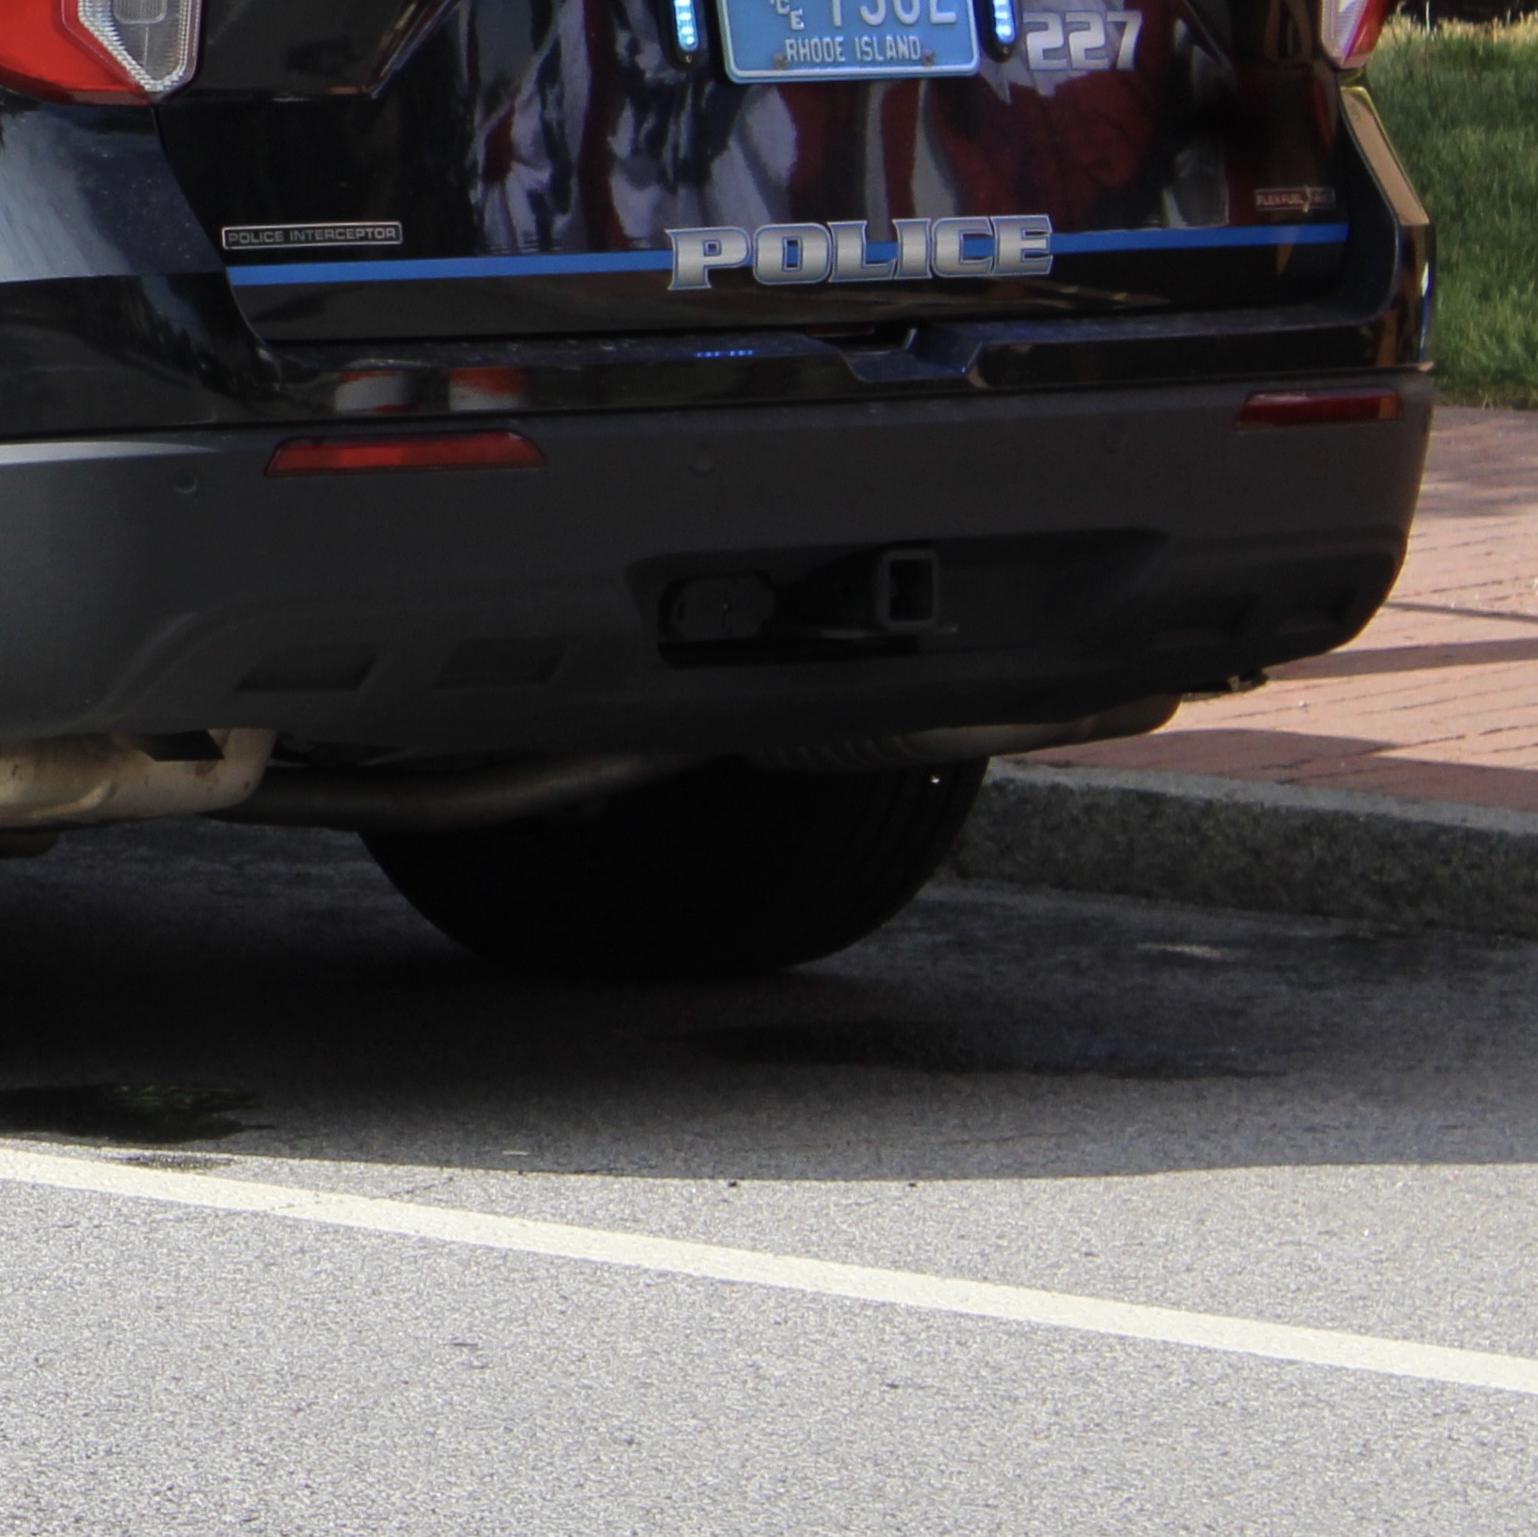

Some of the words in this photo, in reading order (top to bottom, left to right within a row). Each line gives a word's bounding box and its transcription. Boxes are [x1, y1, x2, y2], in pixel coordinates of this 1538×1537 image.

[785, 35, 846, 63] RHODE
[854, 34, 921, 61] ISLAND
[1022, 10, 1144, 72] 227
[228, 230, 285, 244] POLICE
[289, 226, 397, 242] INTERCEPTOR
[665, 214, 1054, 291] POLICE
